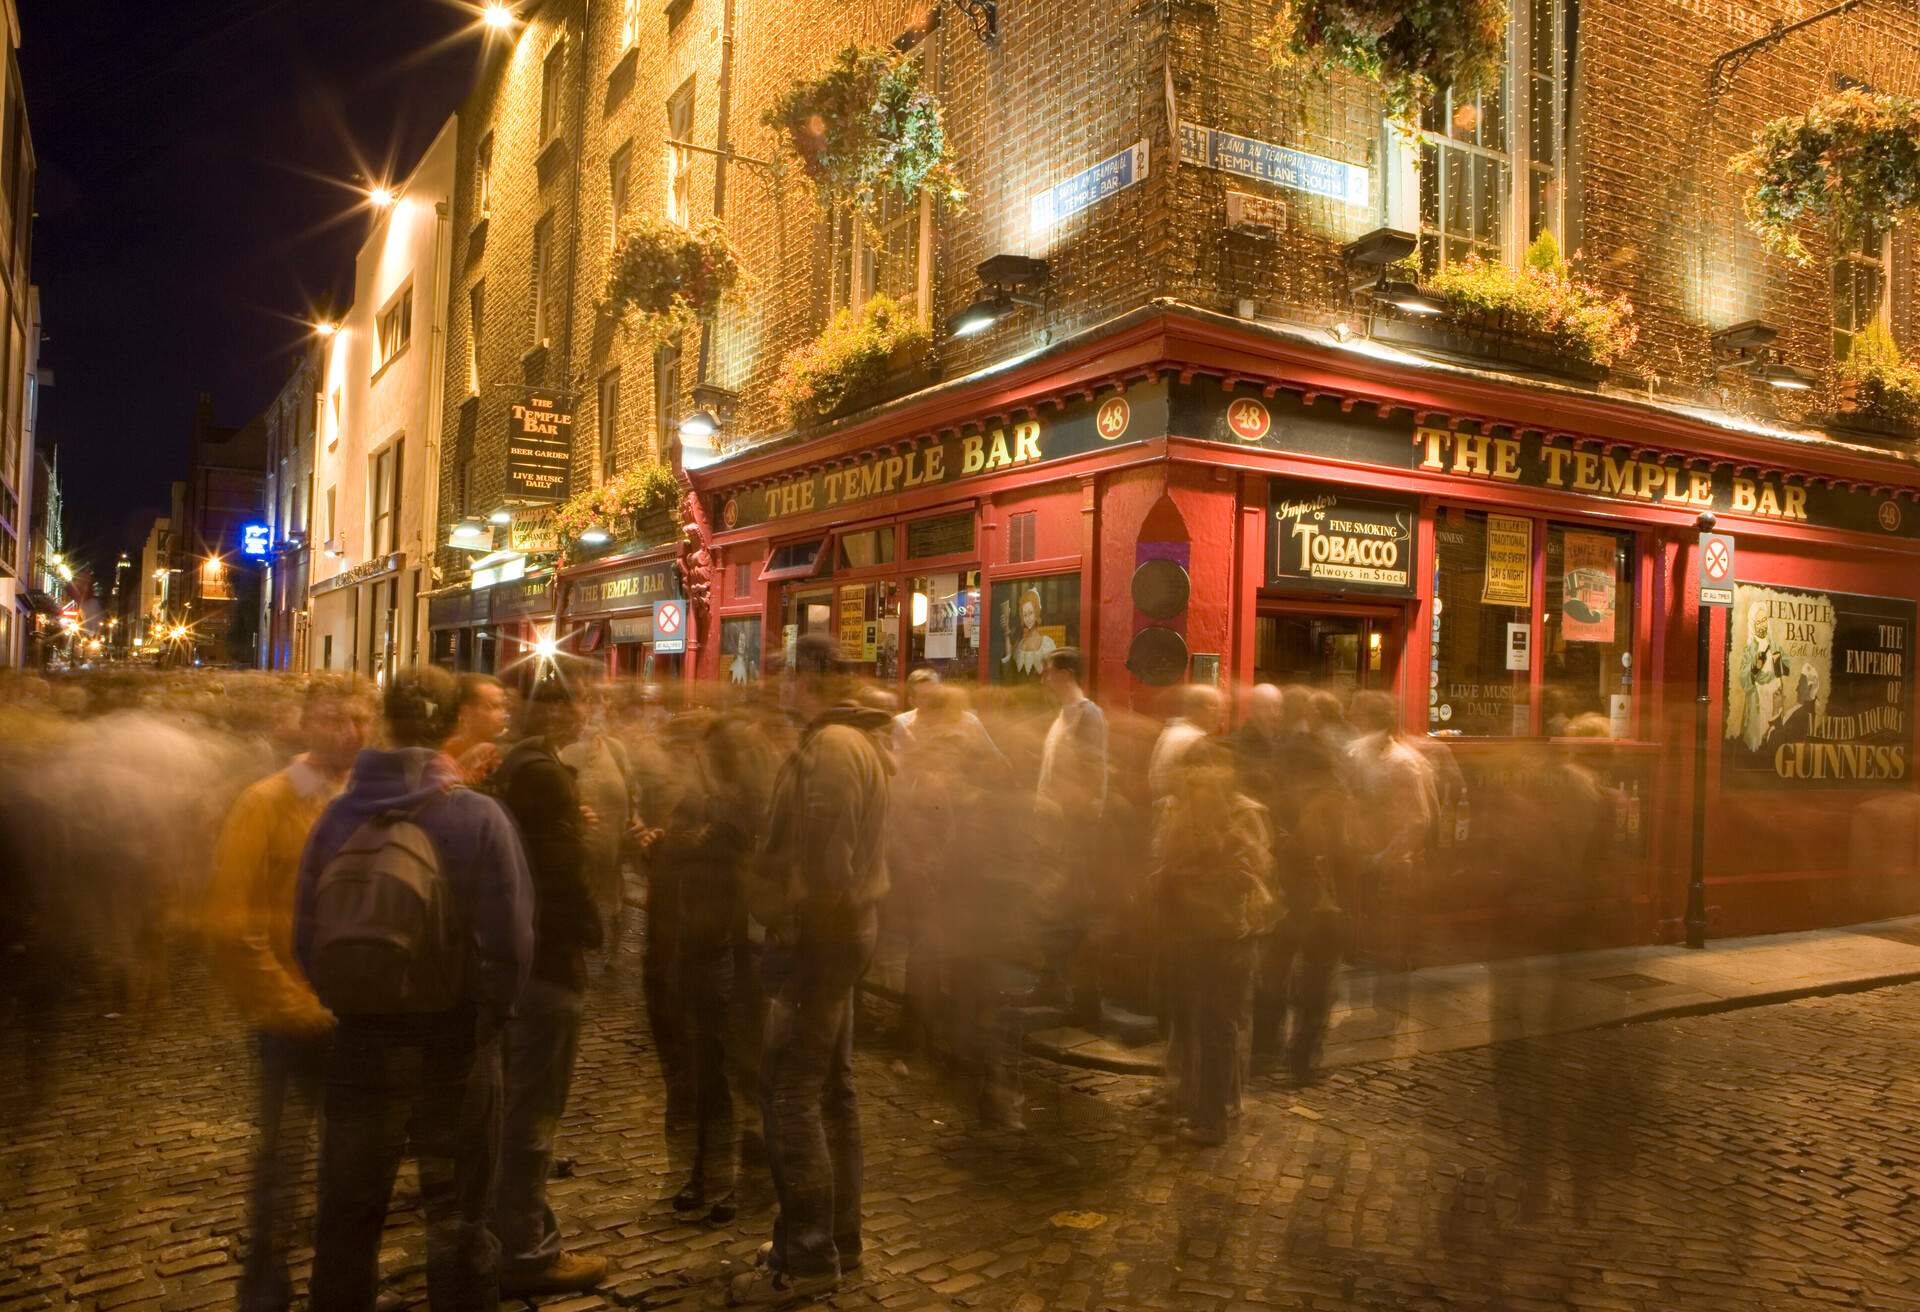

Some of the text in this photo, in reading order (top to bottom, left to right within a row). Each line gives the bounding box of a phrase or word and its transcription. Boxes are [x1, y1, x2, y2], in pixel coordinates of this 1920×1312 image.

[1218, 153, 1343, 194] TEMPLE LANE SOUTH
[1353, 176, 1364, 194] 2
[1064, 176, 1119, 209] TEMPLE BAR
[531, 398, 553, 408] THE
[512, 405, 572, 425] TEMPLE
[1102, 406, 1123, 432] 48
[1234, 403, 1262, 430] 48
[523, 419, 558, 435] BAR
[511, 447, 569, 460] BEER GARDEN
[513, 472, 564, 483] LIVE MUSIC
[765, 420, 1042, 519] THE TEMPLE BAR
[1416, 426, 1808, 520] THE TEMPLE BAR
[525, 480, 552, 489] DAILY
[1276, 494, 1338, 521] Importers
[1314, 511, 1326, 520] OF
[1330, 519, 1398, 538] FINE SMOKING
[1491, 533, 1526, 547] TRADITIONAL
[1292, 523, 1398, 572] TOBACCO
[1313, 563, 1405, 584] Always in Stock
[1491, 567, 1501, 579] DAY
[1507, 569, 1524, 581] NIGHT
[580, 572, 665, 601] THE TEMPLE BAR
[1766, 599, 1832, 624] TEMPLE
[1785, 622, 1817, 645] BAR
[1878, 624, 1903, 649] THE
[1846, 649, 1902, 677] EMPEROR
[1450, 684, 1519, 699] LIVE MUSIC
[1887, 680, 1901, 703] OF
[1467, 702, 1502, 716] DAILY
[1806, 712, 1857, 740] MALTED
[1775, 742, 1905, 780] GUINNESS
